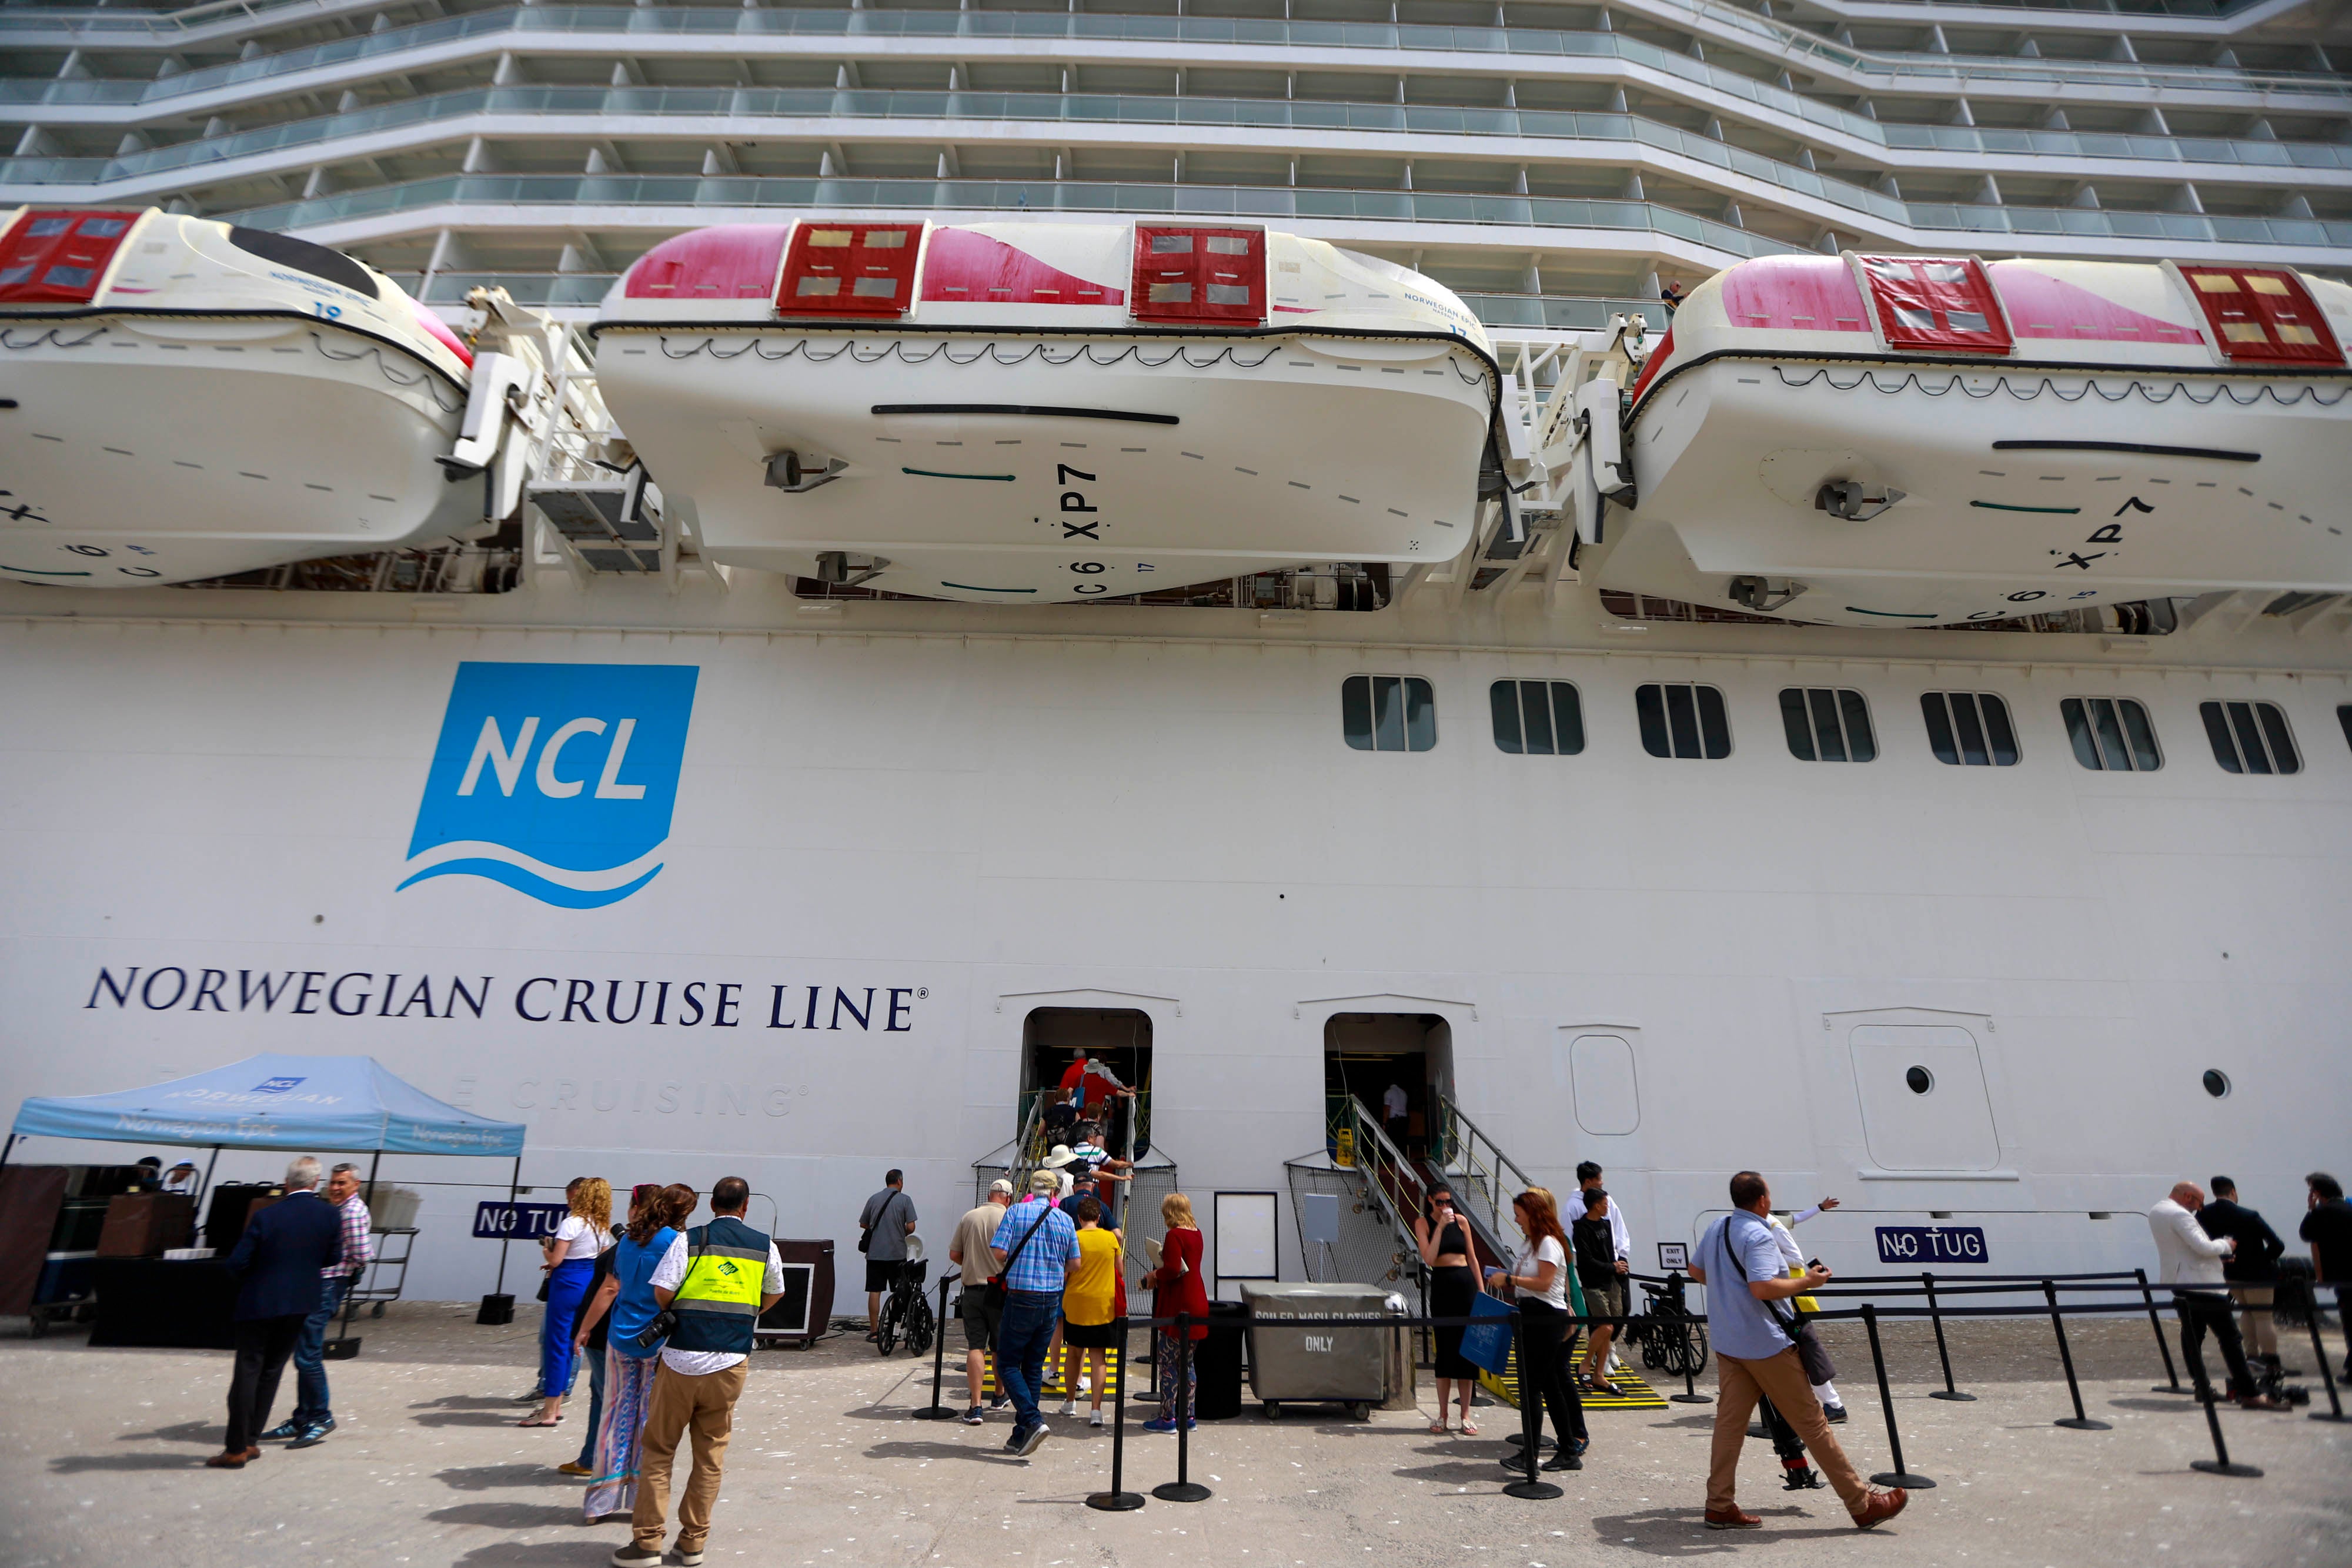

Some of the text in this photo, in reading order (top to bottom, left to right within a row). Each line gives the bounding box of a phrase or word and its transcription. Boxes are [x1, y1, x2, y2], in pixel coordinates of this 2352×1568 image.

[1404, 292, 1476, 330] NORWEGIAN EPIC
[456, 716, 647, 800] NCL
[82, 966, 495, 1019] NORWEGIAN
[514, 977, 743, 1028] CRUISE
[477, 1208, 566, 1234] NO TU
[1882, 1232, 1981, 1257] NO TUG
[1305, 1336, 1334, 1352] ONLY
